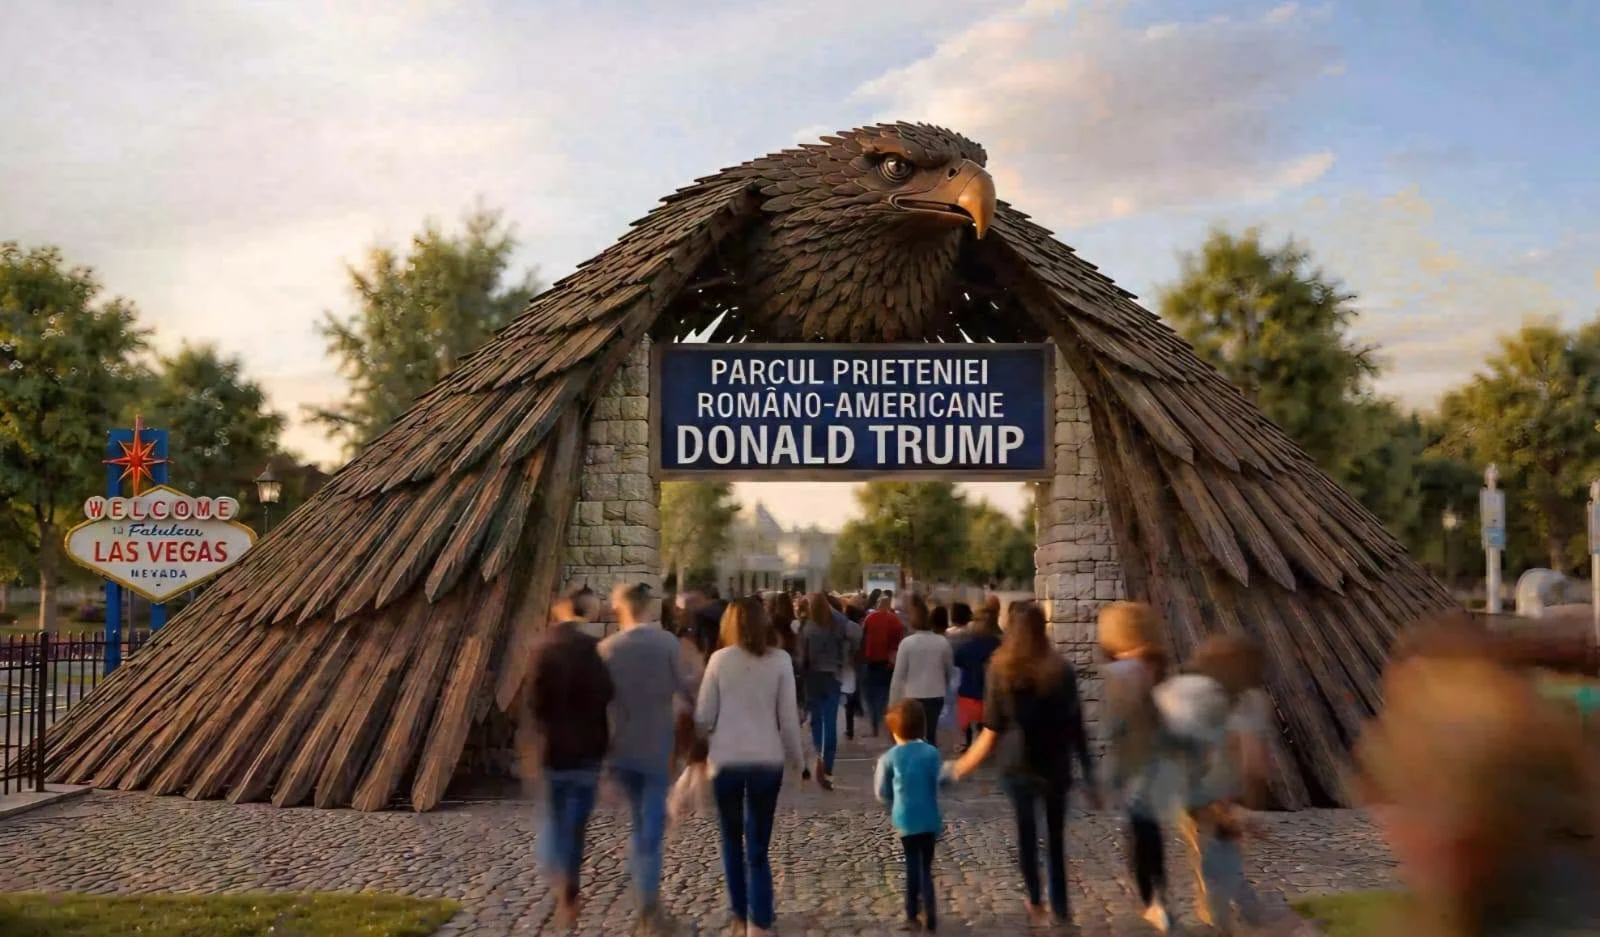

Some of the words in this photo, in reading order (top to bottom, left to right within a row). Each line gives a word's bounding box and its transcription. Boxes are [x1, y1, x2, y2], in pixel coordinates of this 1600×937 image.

[711, 359, 824, 385] PARCUL
[833, 359, 988, 385] PRIETENIEI
[697, 387, 1004, 418] ROMÂNO-AMERICANE
[677, 425, 855, 464] DONALD
[868, 425, 1025, 464] TRUMP
[89, 501, 230, 517] WELCOME
[94, 541, 139, 562] LAS
[147, 541, 228, 562] VEGAS
[131, 569, 188, 578] NEVADA
